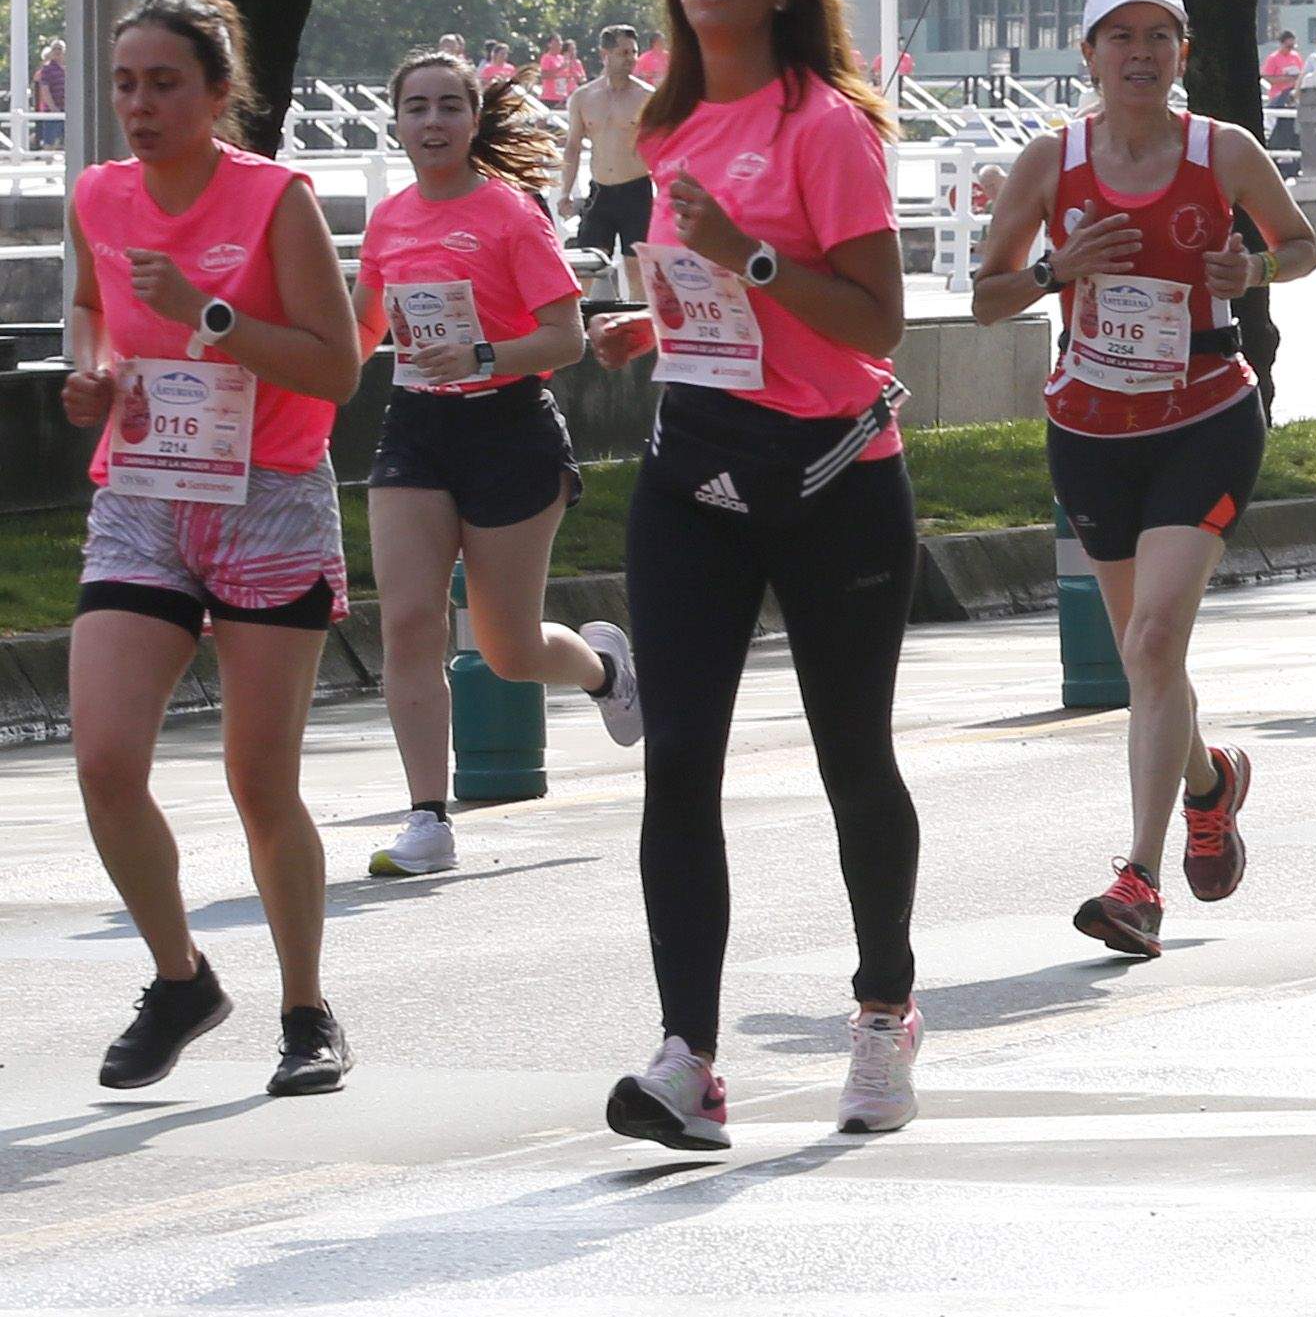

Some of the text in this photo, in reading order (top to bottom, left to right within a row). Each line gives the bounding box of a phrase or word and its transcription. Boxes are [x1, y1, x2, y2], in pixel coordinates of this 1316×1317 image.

[684, 301, 722, 320] 016
[412, 323, 447, 339] 016
[1101, 320, 1144, 340] 016
[1108, 343, 1135, 355] 2254
[154, 415, 198, 436] 016
[159, 440, 188, 453] 2214
[695, 491, 749, 513] adidas
